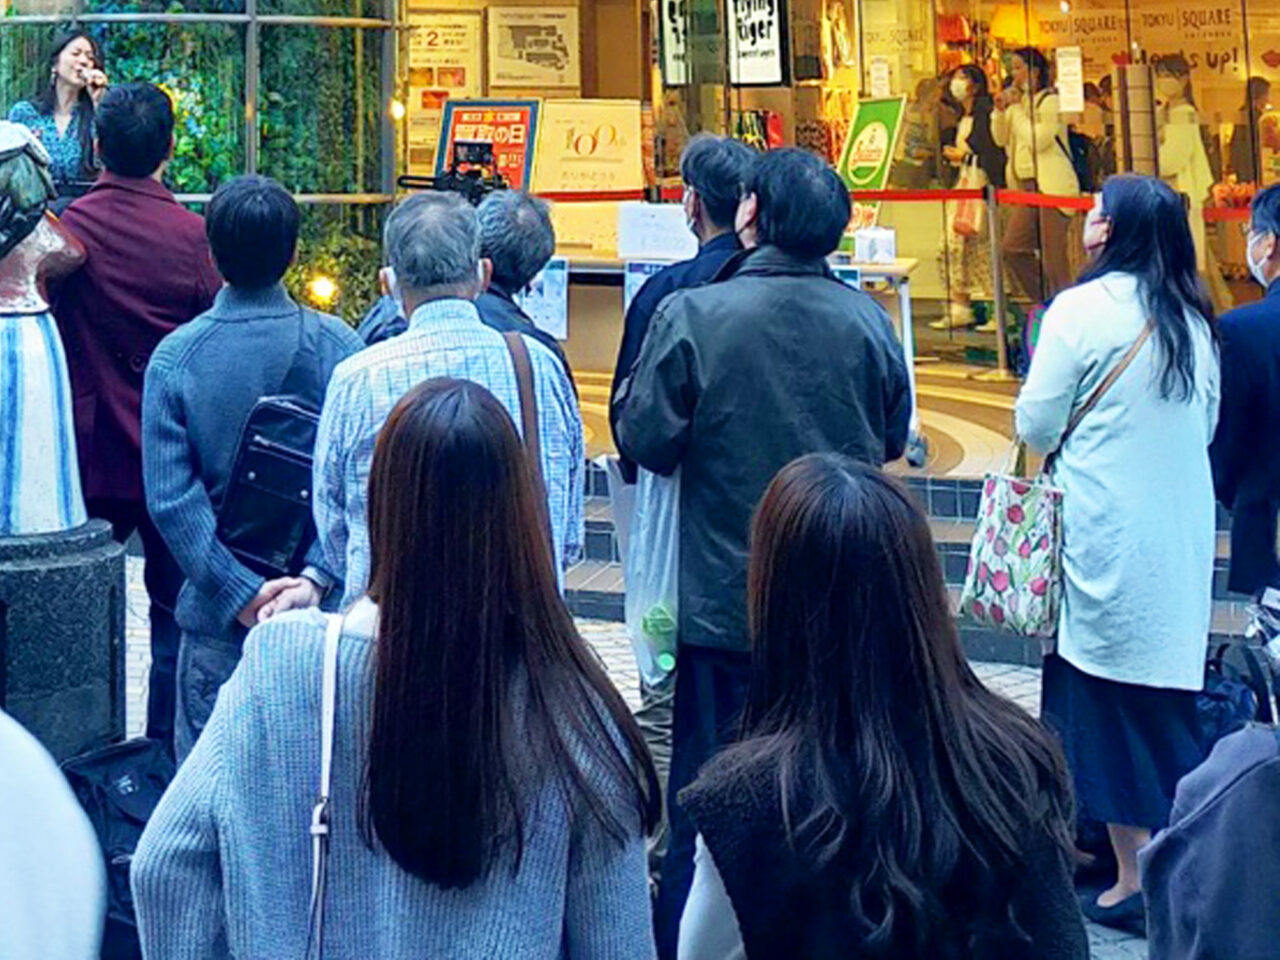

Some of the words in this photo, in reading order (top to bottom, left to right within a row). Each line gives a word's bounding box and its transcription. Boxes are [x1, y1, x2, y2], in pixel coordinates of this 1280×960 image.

[1074, 16, 1117, 36] SQUARE
[1182, 8, 1231, 30] SQUARE
[426, 30, 439, 46] 2
[736, 18, 774, 46] tiger
[1206, 47, 1238, 74] up!
